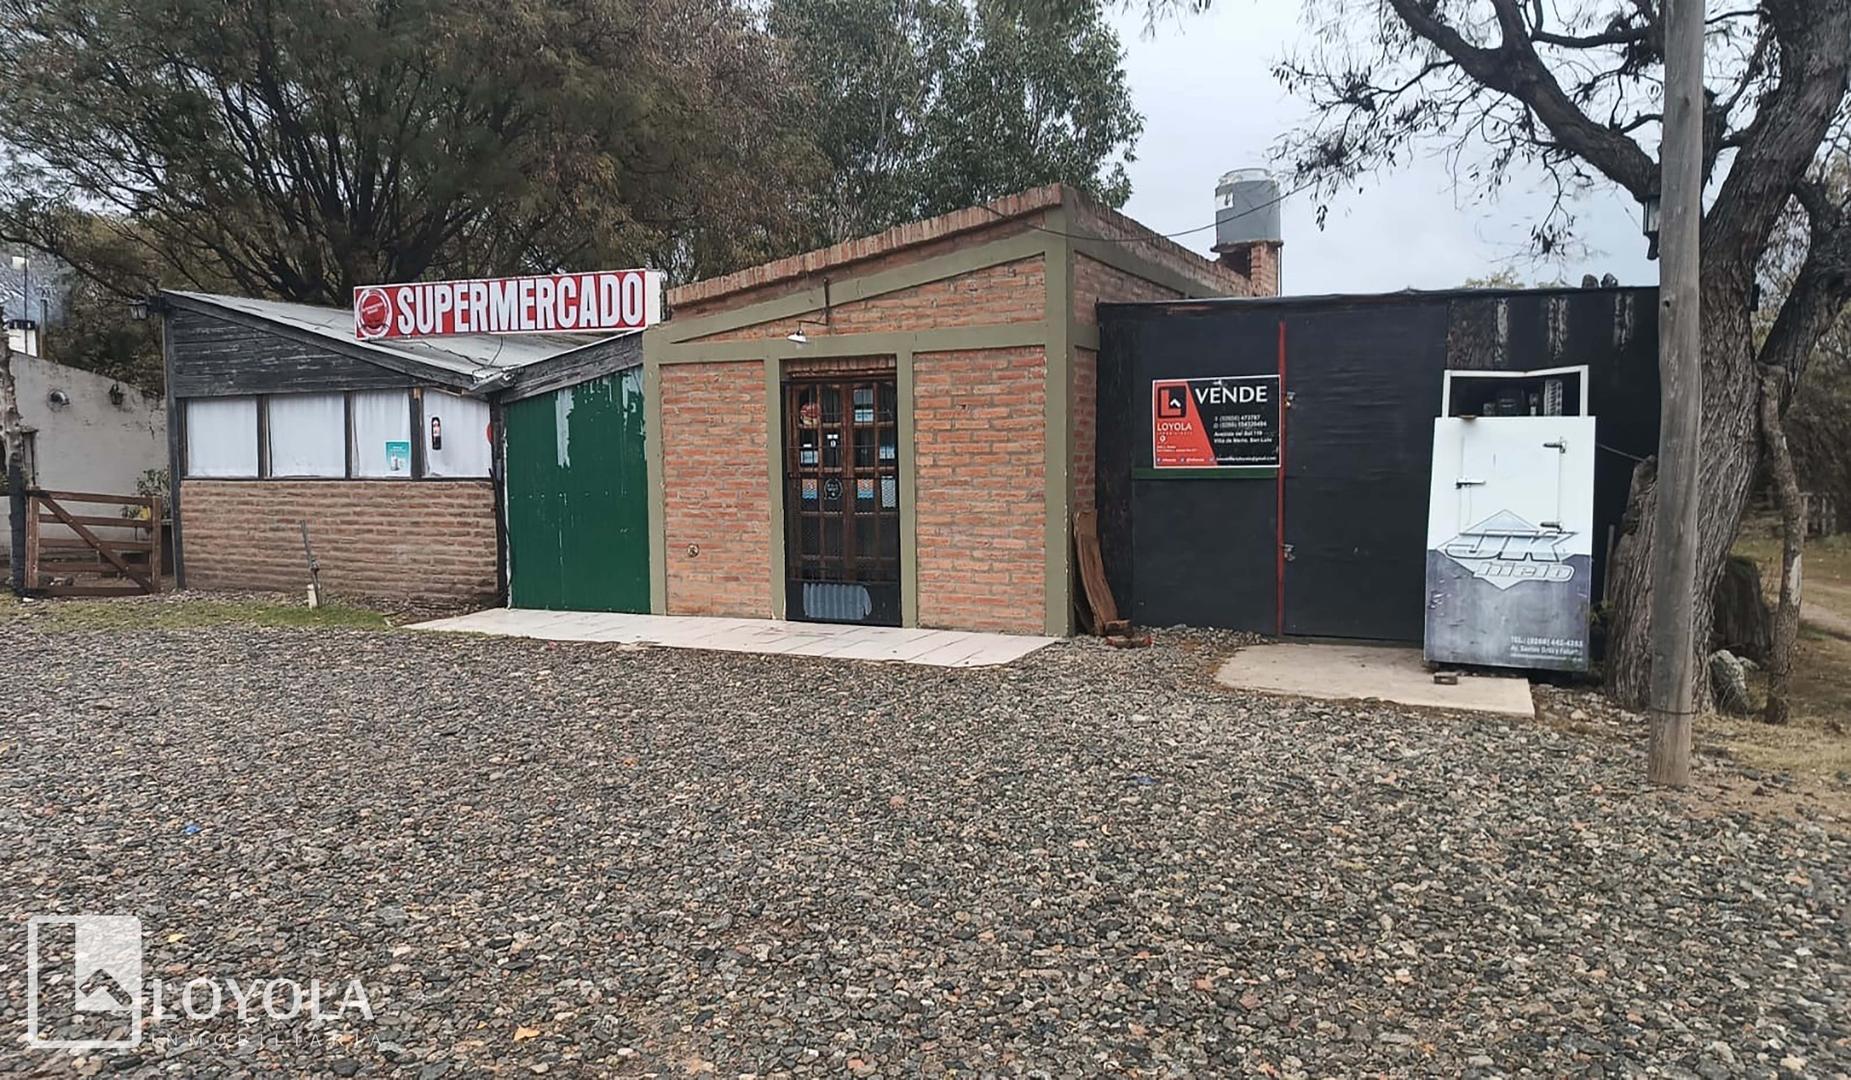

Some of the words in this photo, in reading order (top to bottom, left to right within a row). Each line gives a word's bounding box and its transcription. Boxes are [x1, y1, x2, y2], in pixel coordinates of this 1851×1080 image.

[396, 271, 643, 335] SUPERMERCADO
[1194, 385, 1268, 404] VENDE
[1156, 422, 1193, 432] LOYOLA
